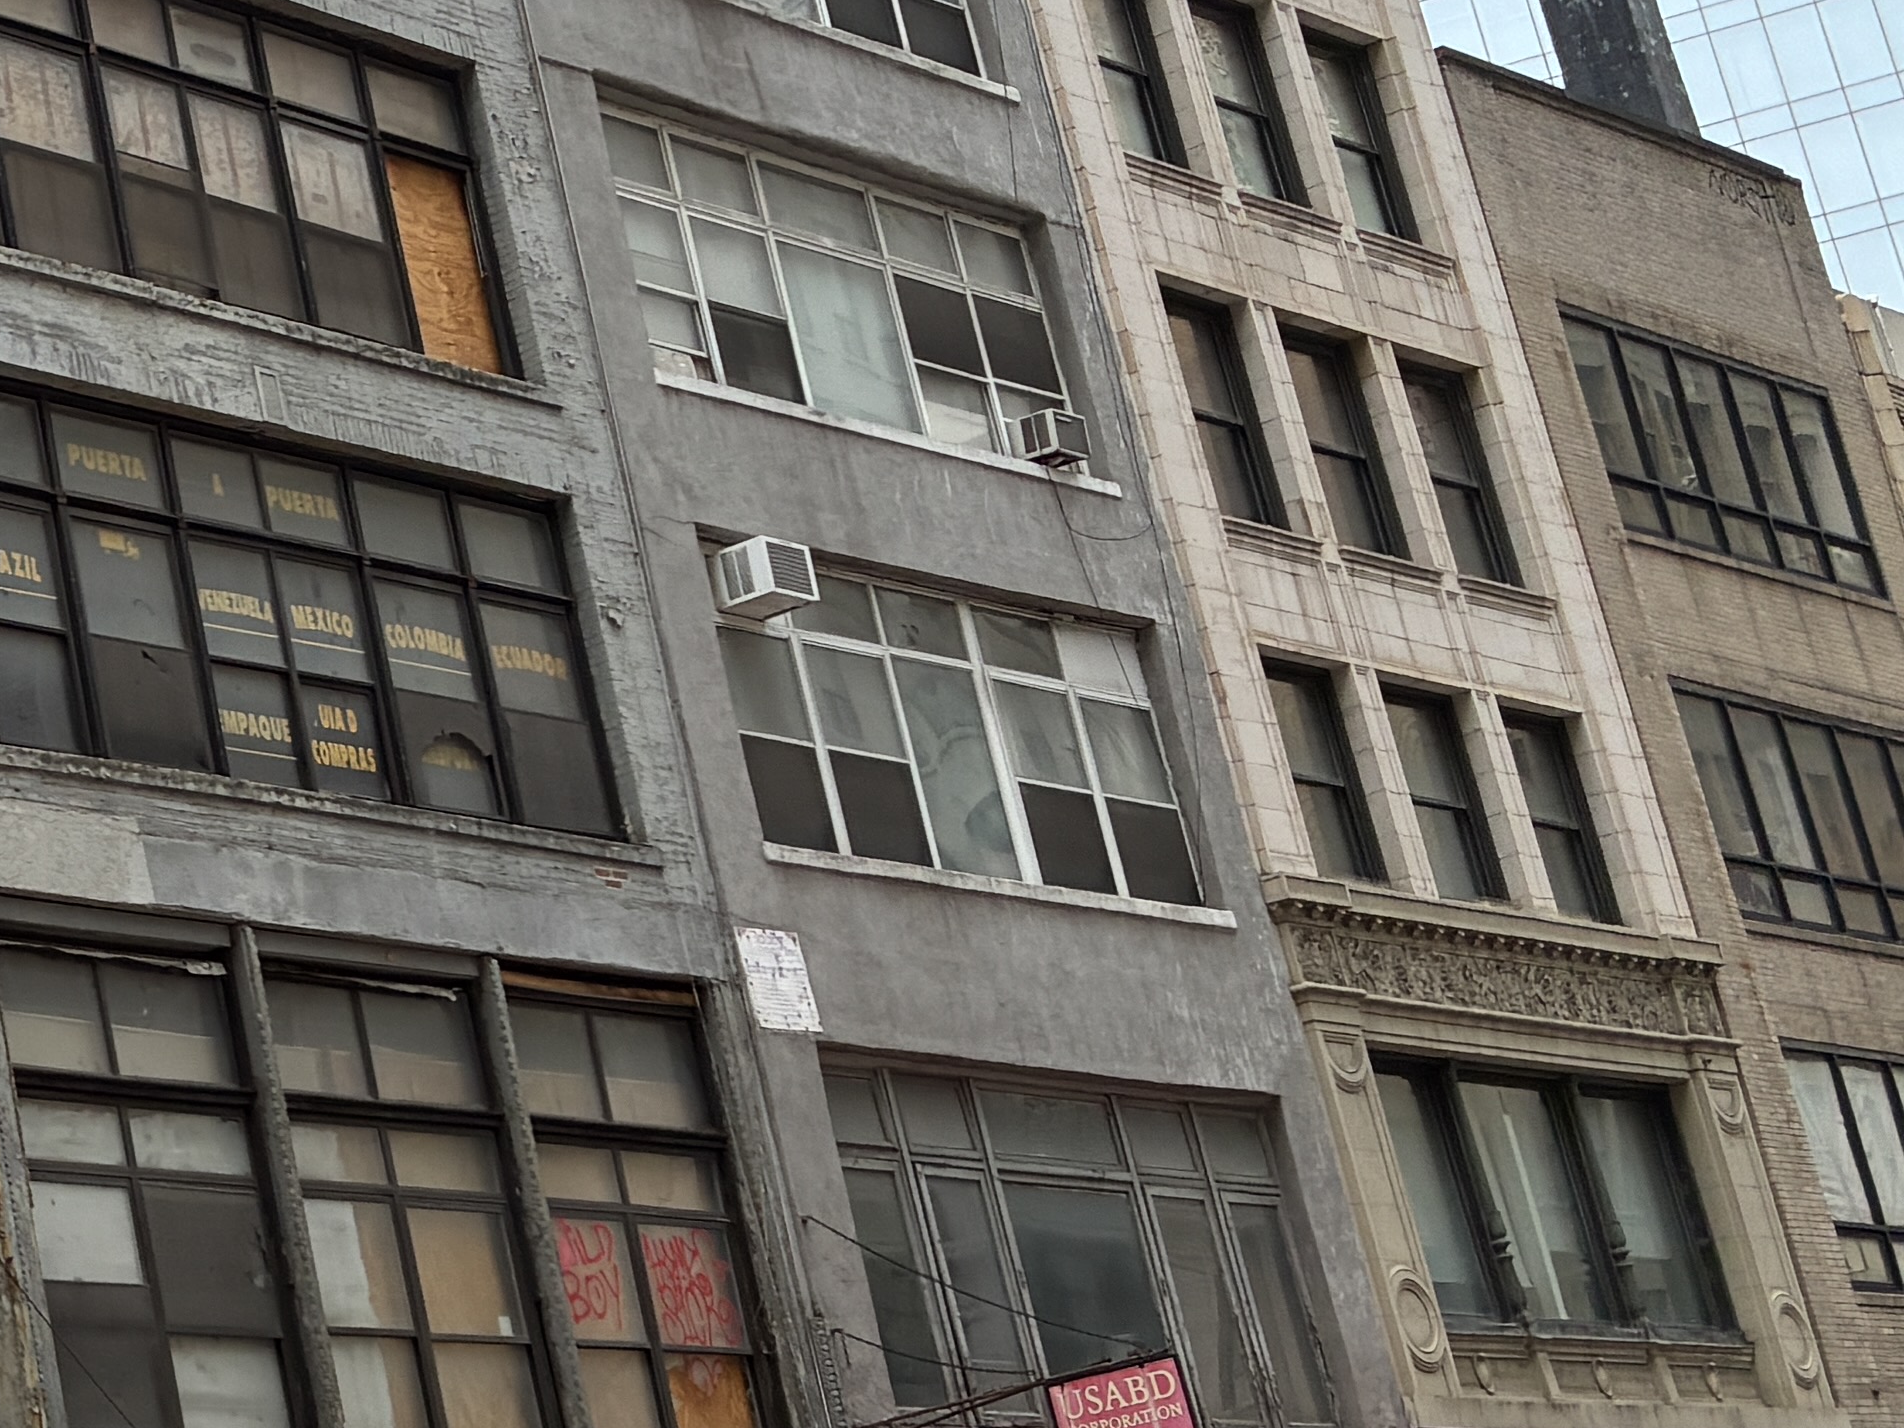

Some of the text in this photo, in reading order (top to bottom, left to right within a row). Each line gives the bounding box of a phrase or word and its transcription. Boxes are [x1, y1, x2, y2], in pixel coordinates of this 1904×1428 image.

[66, 442, 147, 482] PUERTA
[264, 484, 340, 522] PUERTA
[198, 587, 275, 624] VENEZUELA
[290, 604, 354, 639] MEXICO
[384, 623, 467, 662] COLOMBIA
[491, 644, 568, 681] ECUADOR
[314, 703, 345, 732] UIA
[310, 738, 378, 772] COMPRAS
[1059, 1370, 1177, 1420] USABD
